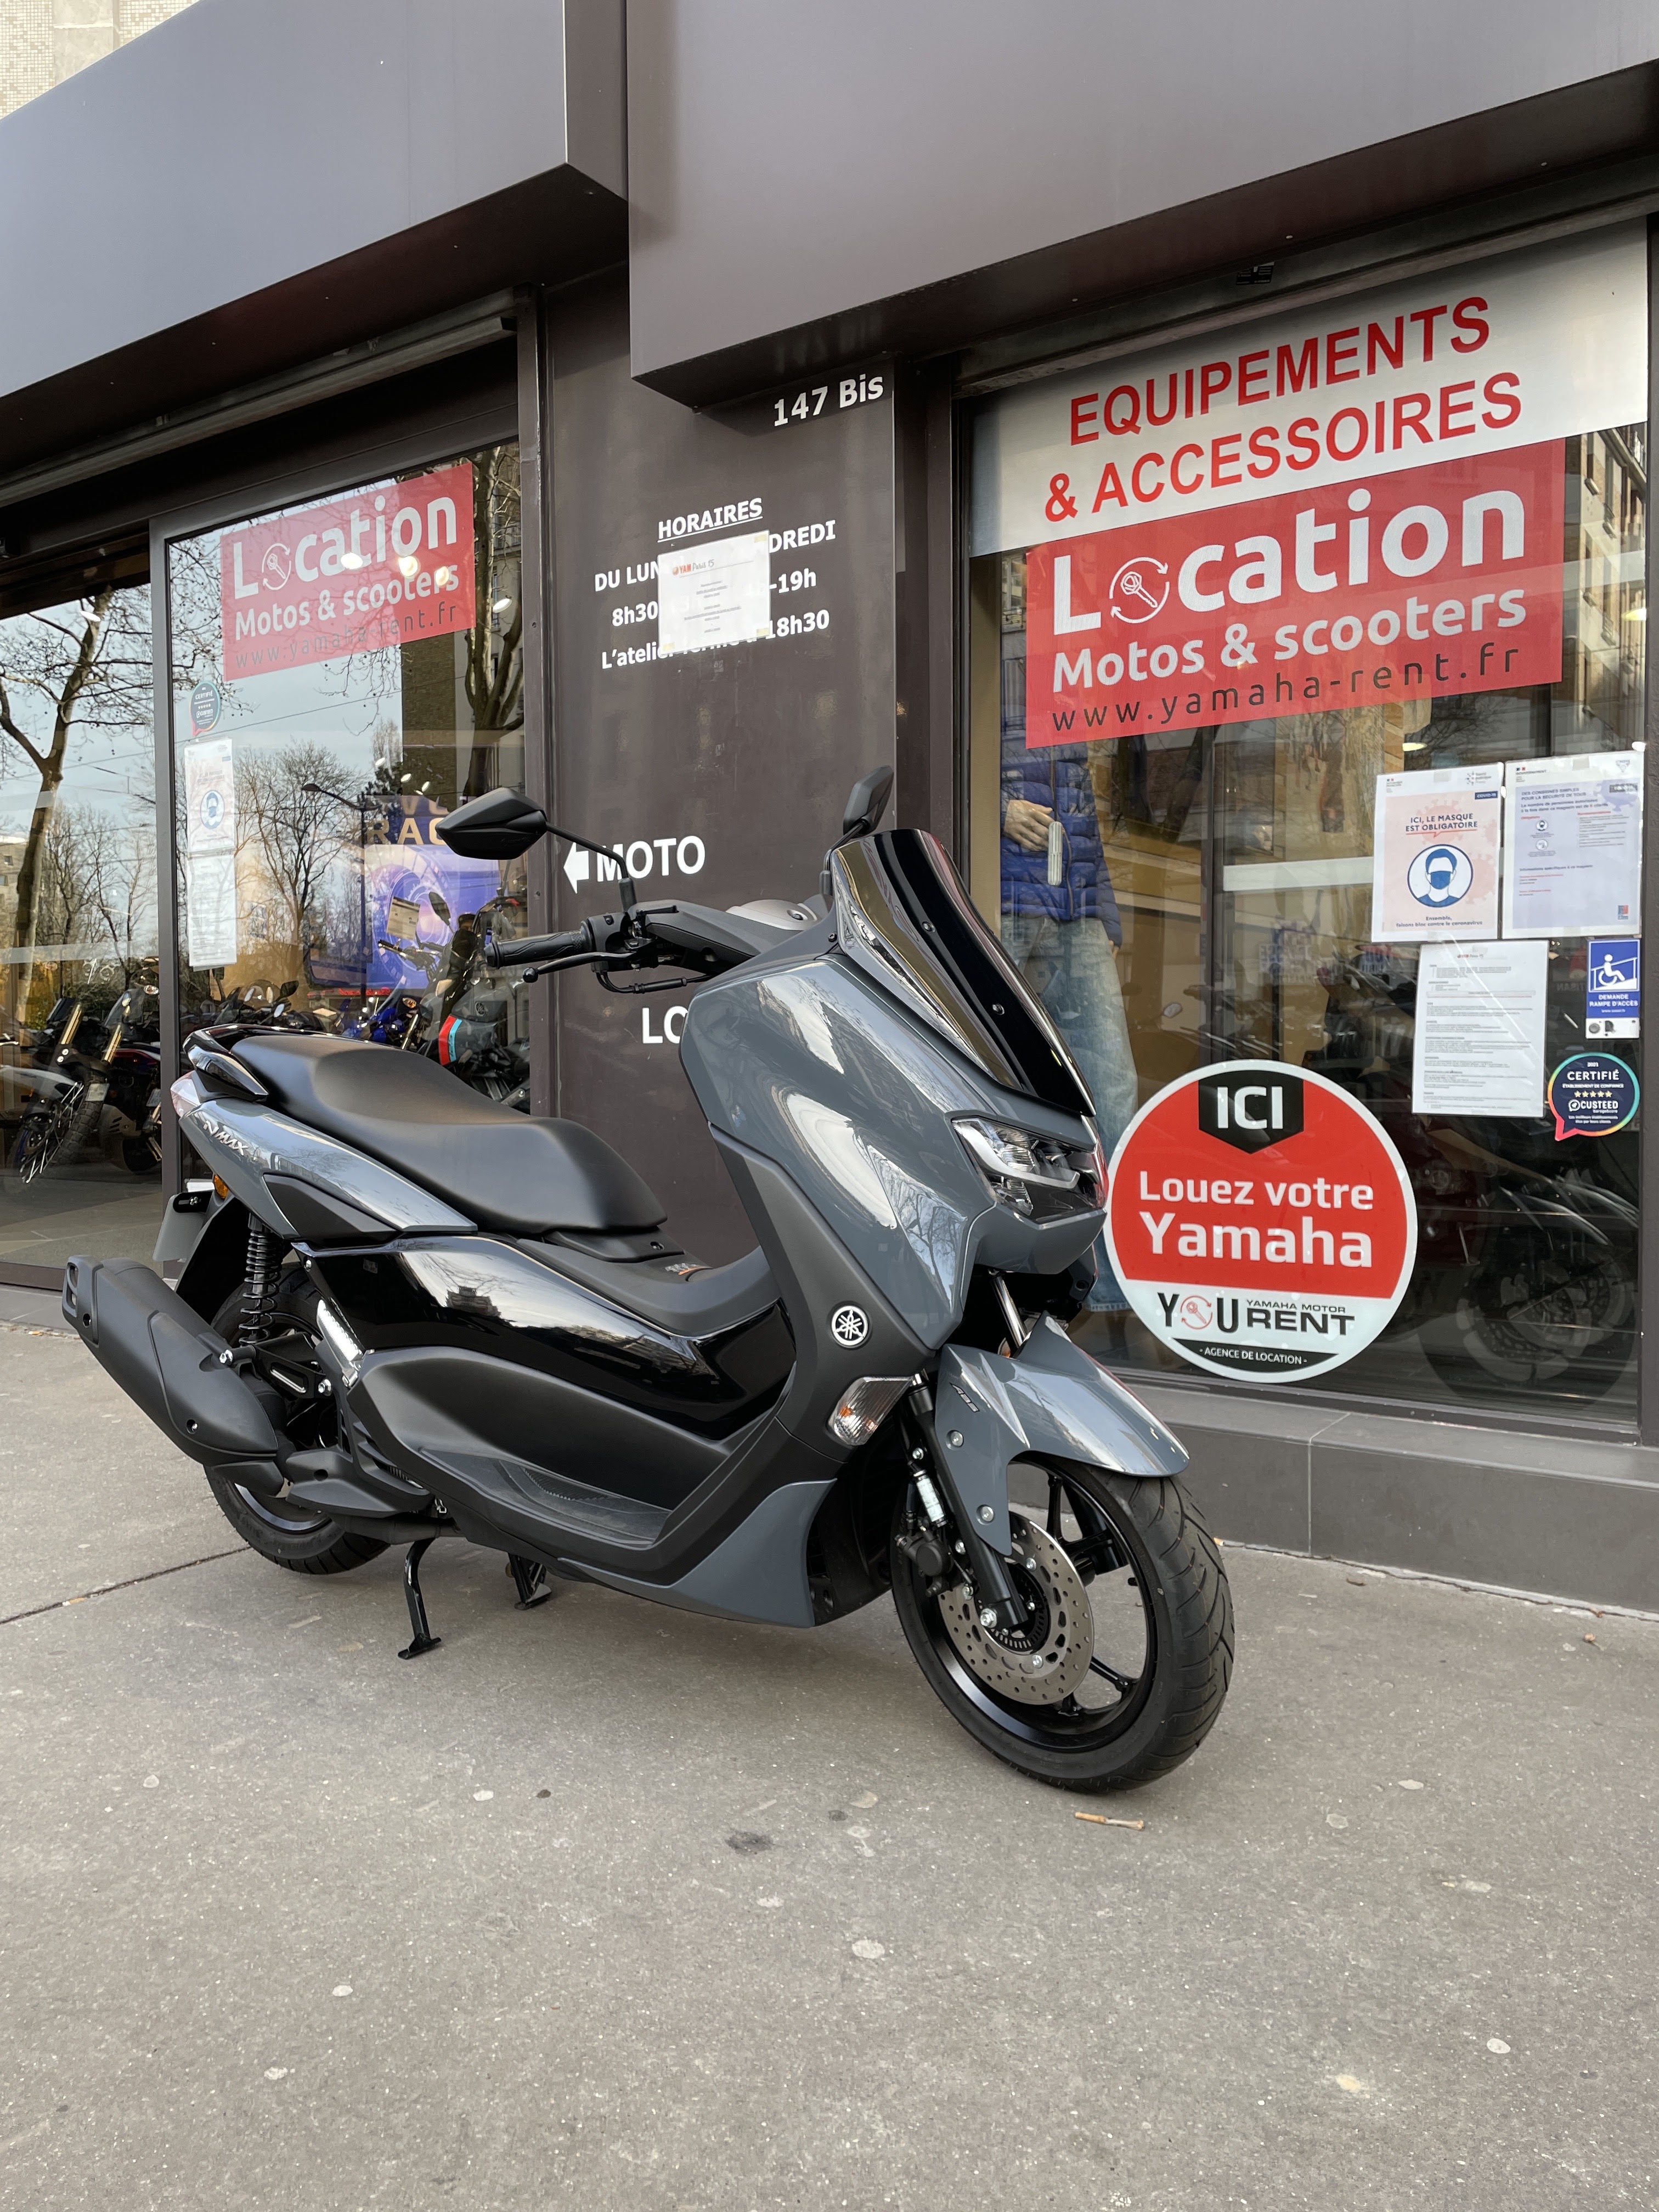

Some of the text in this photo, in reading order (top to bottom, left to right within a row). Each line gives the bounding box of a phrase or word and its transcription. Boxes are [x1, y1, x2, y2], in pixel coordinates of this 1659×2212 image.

[1070, 296, 1489, 446] EQUIPEMENTS
[774, 374, 884, 427] 147 Bis
[1044, 372, 1521, 522] & ACCESSOIRES
[658, 498, 763, 540] HORAIRES
[595, 520, 836, 592] DU LUN DREDI
[235, 564, 459, 641] Motos & scooters
[236, 601, 457, 669] www.yamaha-rent.fr
[602, 642, 674, 669] L'ateli
[766, 609, 830, 639] 18h30
[1053, 588, 1526, 693] Motos & scooters
[1052, 643, 1520, 731] www.yamaha-rent.fr
[1422, 821, 1478, 831] OBLIGATOIRE
[1438, 813, 1473, 822] MASQUE
[597, 836, 706, 883] MOTO
[1567, 1069, 1620, 1080] CERTIFIÉ
[1216, 1086, 1283, 1130] ICI
[1581, 1100, 1618, 1109] CUSTEED
[203, 1120, 250, 1156] NMAX
[1139, 1171, 1373, 1210] Louez votre
[1139, 1211, 1372, 1268] Yamaha
[1246, 1299, 1346, 1313] YAMAHA MOTOR
[1246, 1307, 1355, 1336] RENT
[1204, 1347, 1302, 1365] AGENCE DE LOCATION
